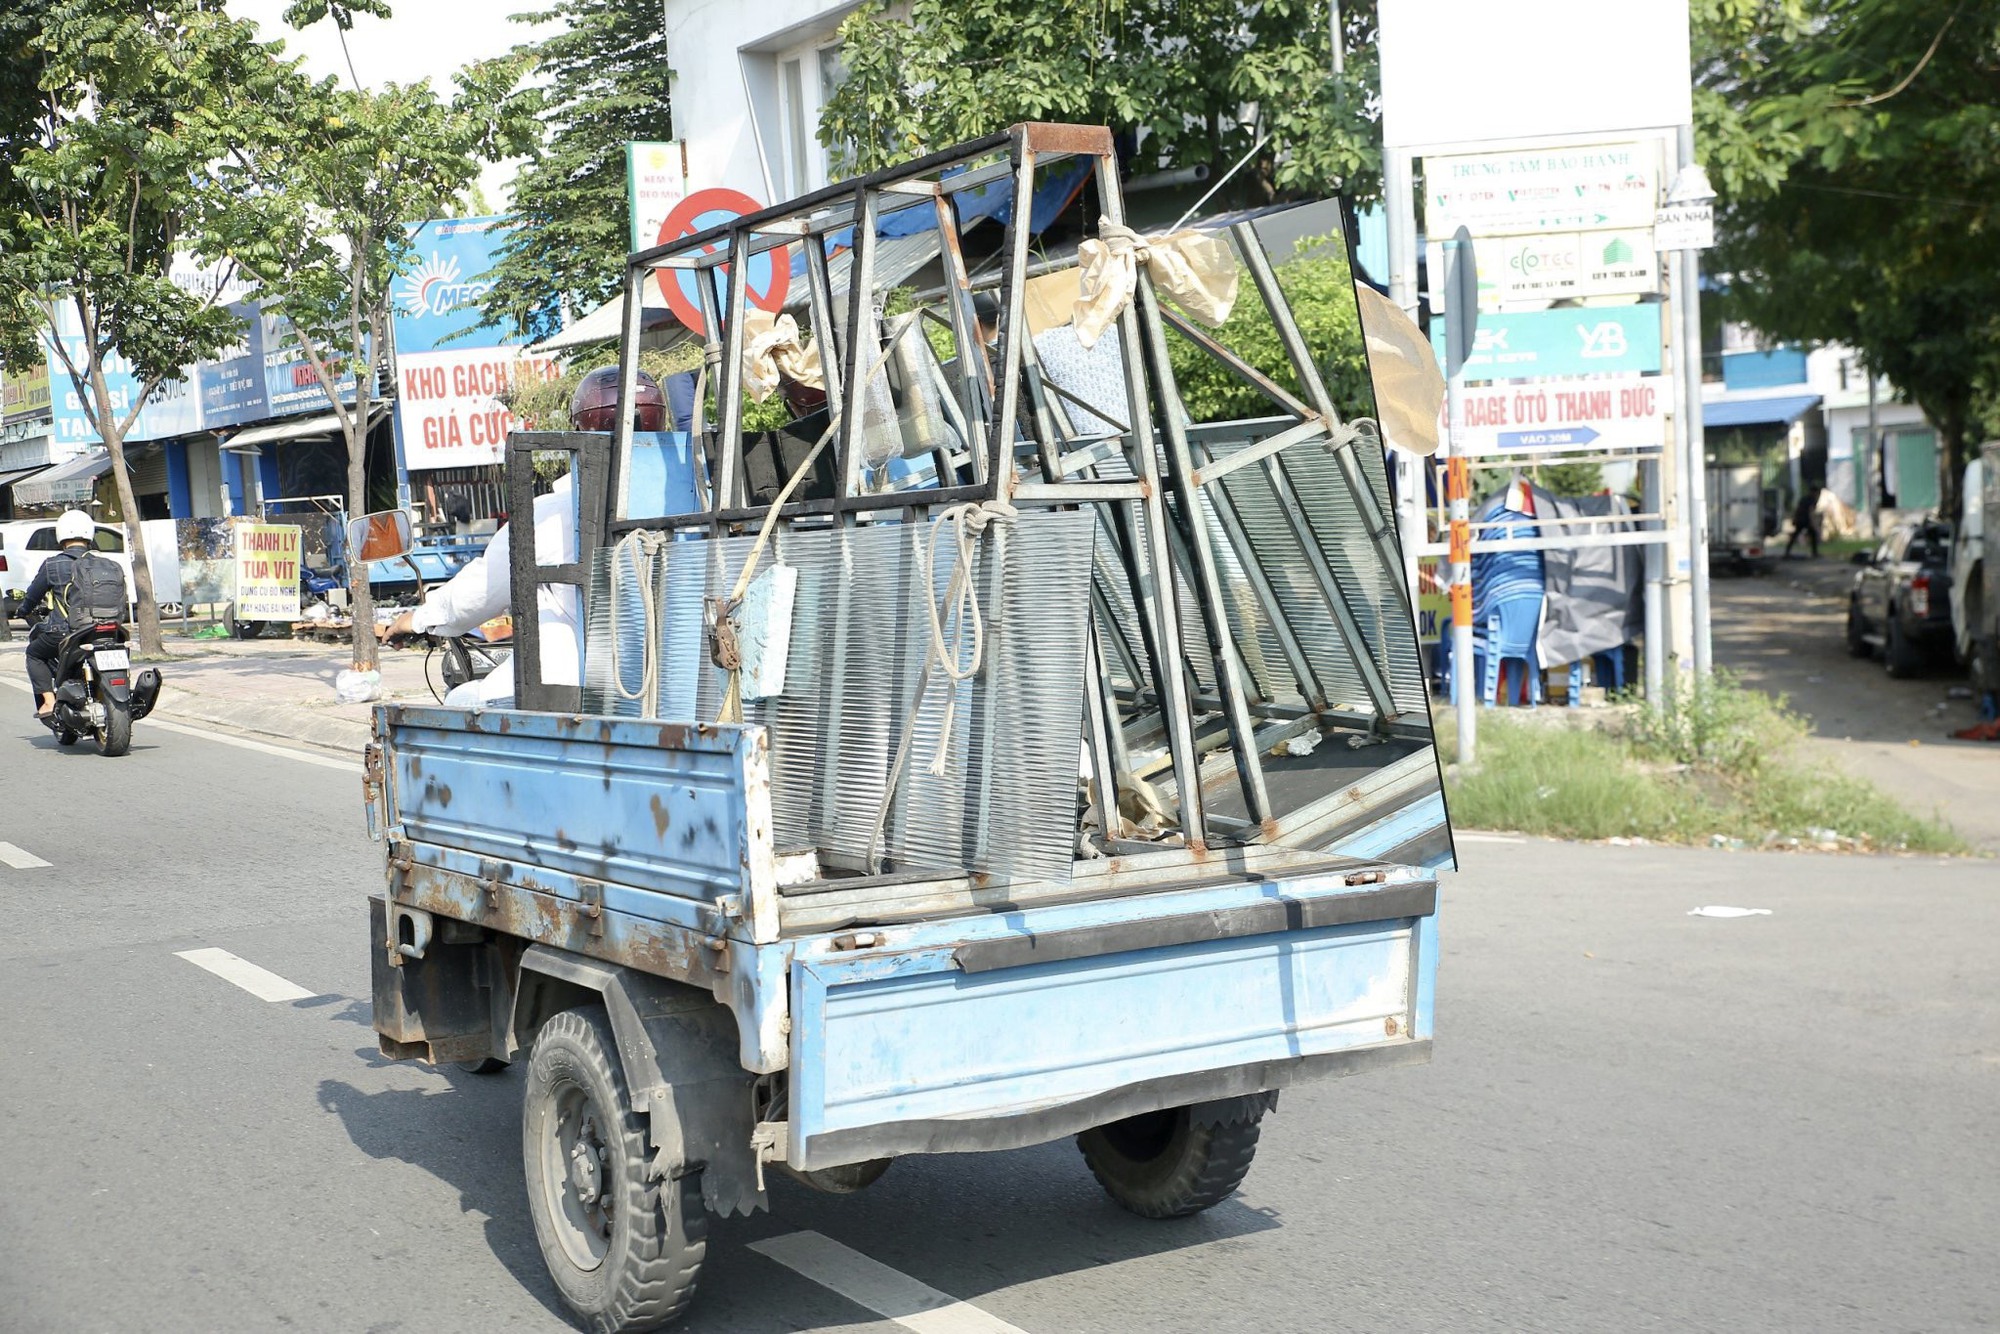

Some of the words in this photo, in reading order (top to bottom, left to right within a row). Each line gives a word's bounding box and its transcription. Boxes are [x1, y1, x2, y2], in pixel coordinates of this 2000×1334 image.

[405, 365, 446, 400] KHO
[452, 361, 508, 403] GẠCH
[1555, 390, 1612, 422] THANH
[423, 408, 463, 449] GIÁ
[242, 532, 280, 551] THANH
[283, 529, 297, 552] LÝ
[243, 560, 269, 579] TUA
[274, 557, 295, 580] VÍT
